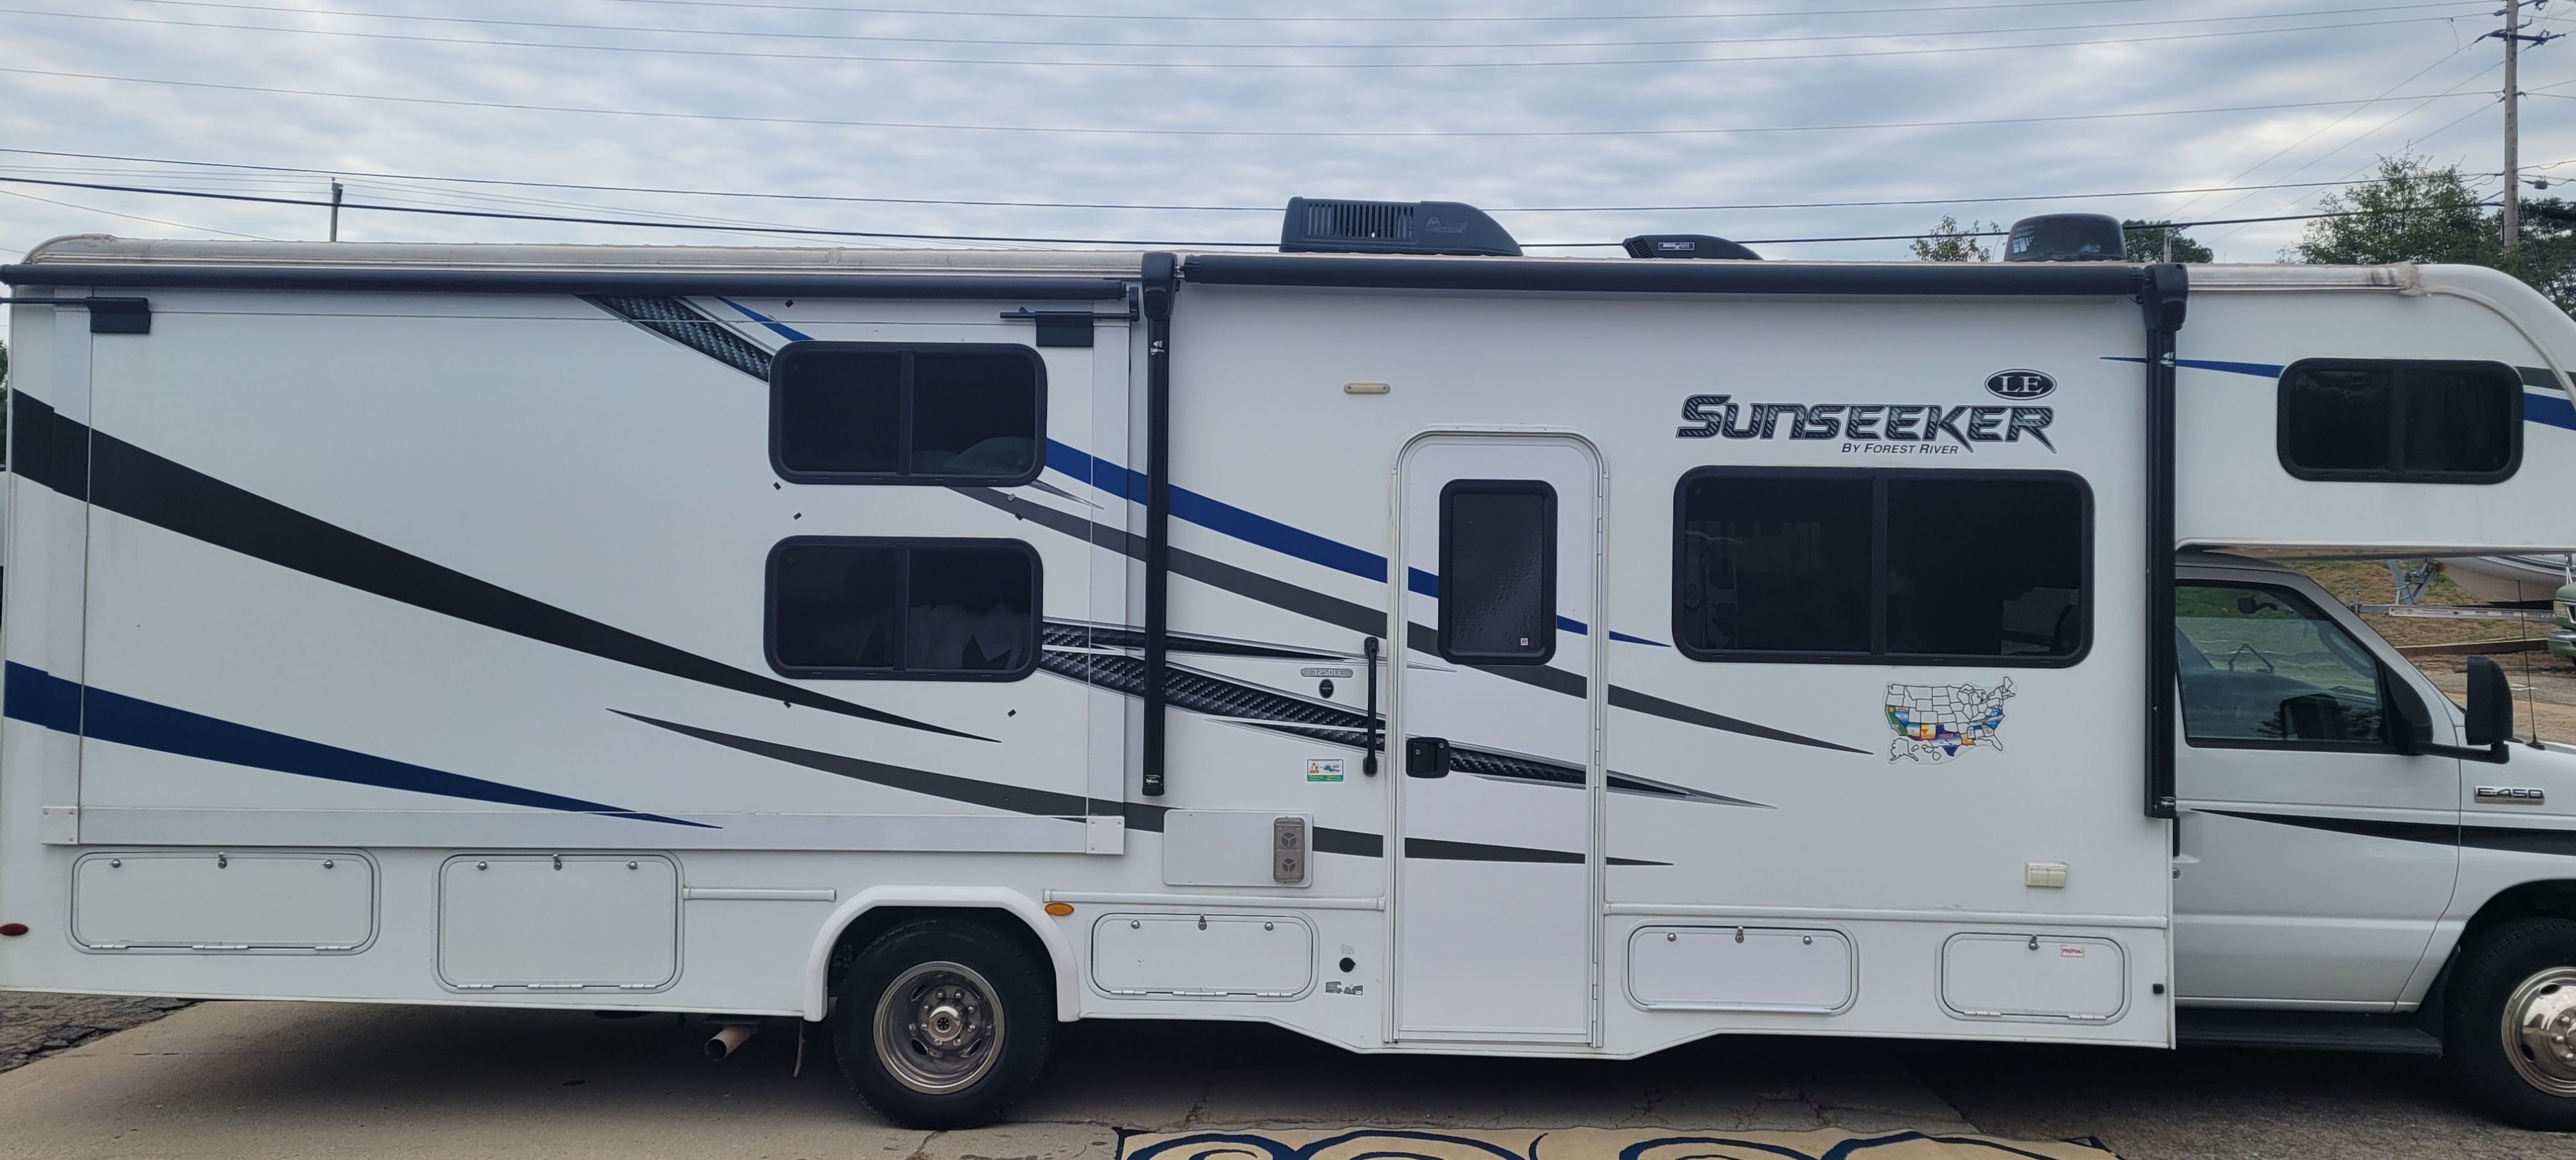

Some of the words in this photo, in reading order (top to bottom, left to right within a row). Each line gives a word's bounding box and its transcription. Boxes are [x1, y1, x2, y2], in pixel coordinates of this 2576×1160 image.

[1998, 375, 2043, 394] LE
[1842, 443, 1861, 453] BY
[1864, 444, 1917, 454] FOREST
[1919, 444, 1958, 454] RIVER
[2476, 787, 2544, 799] E-450
